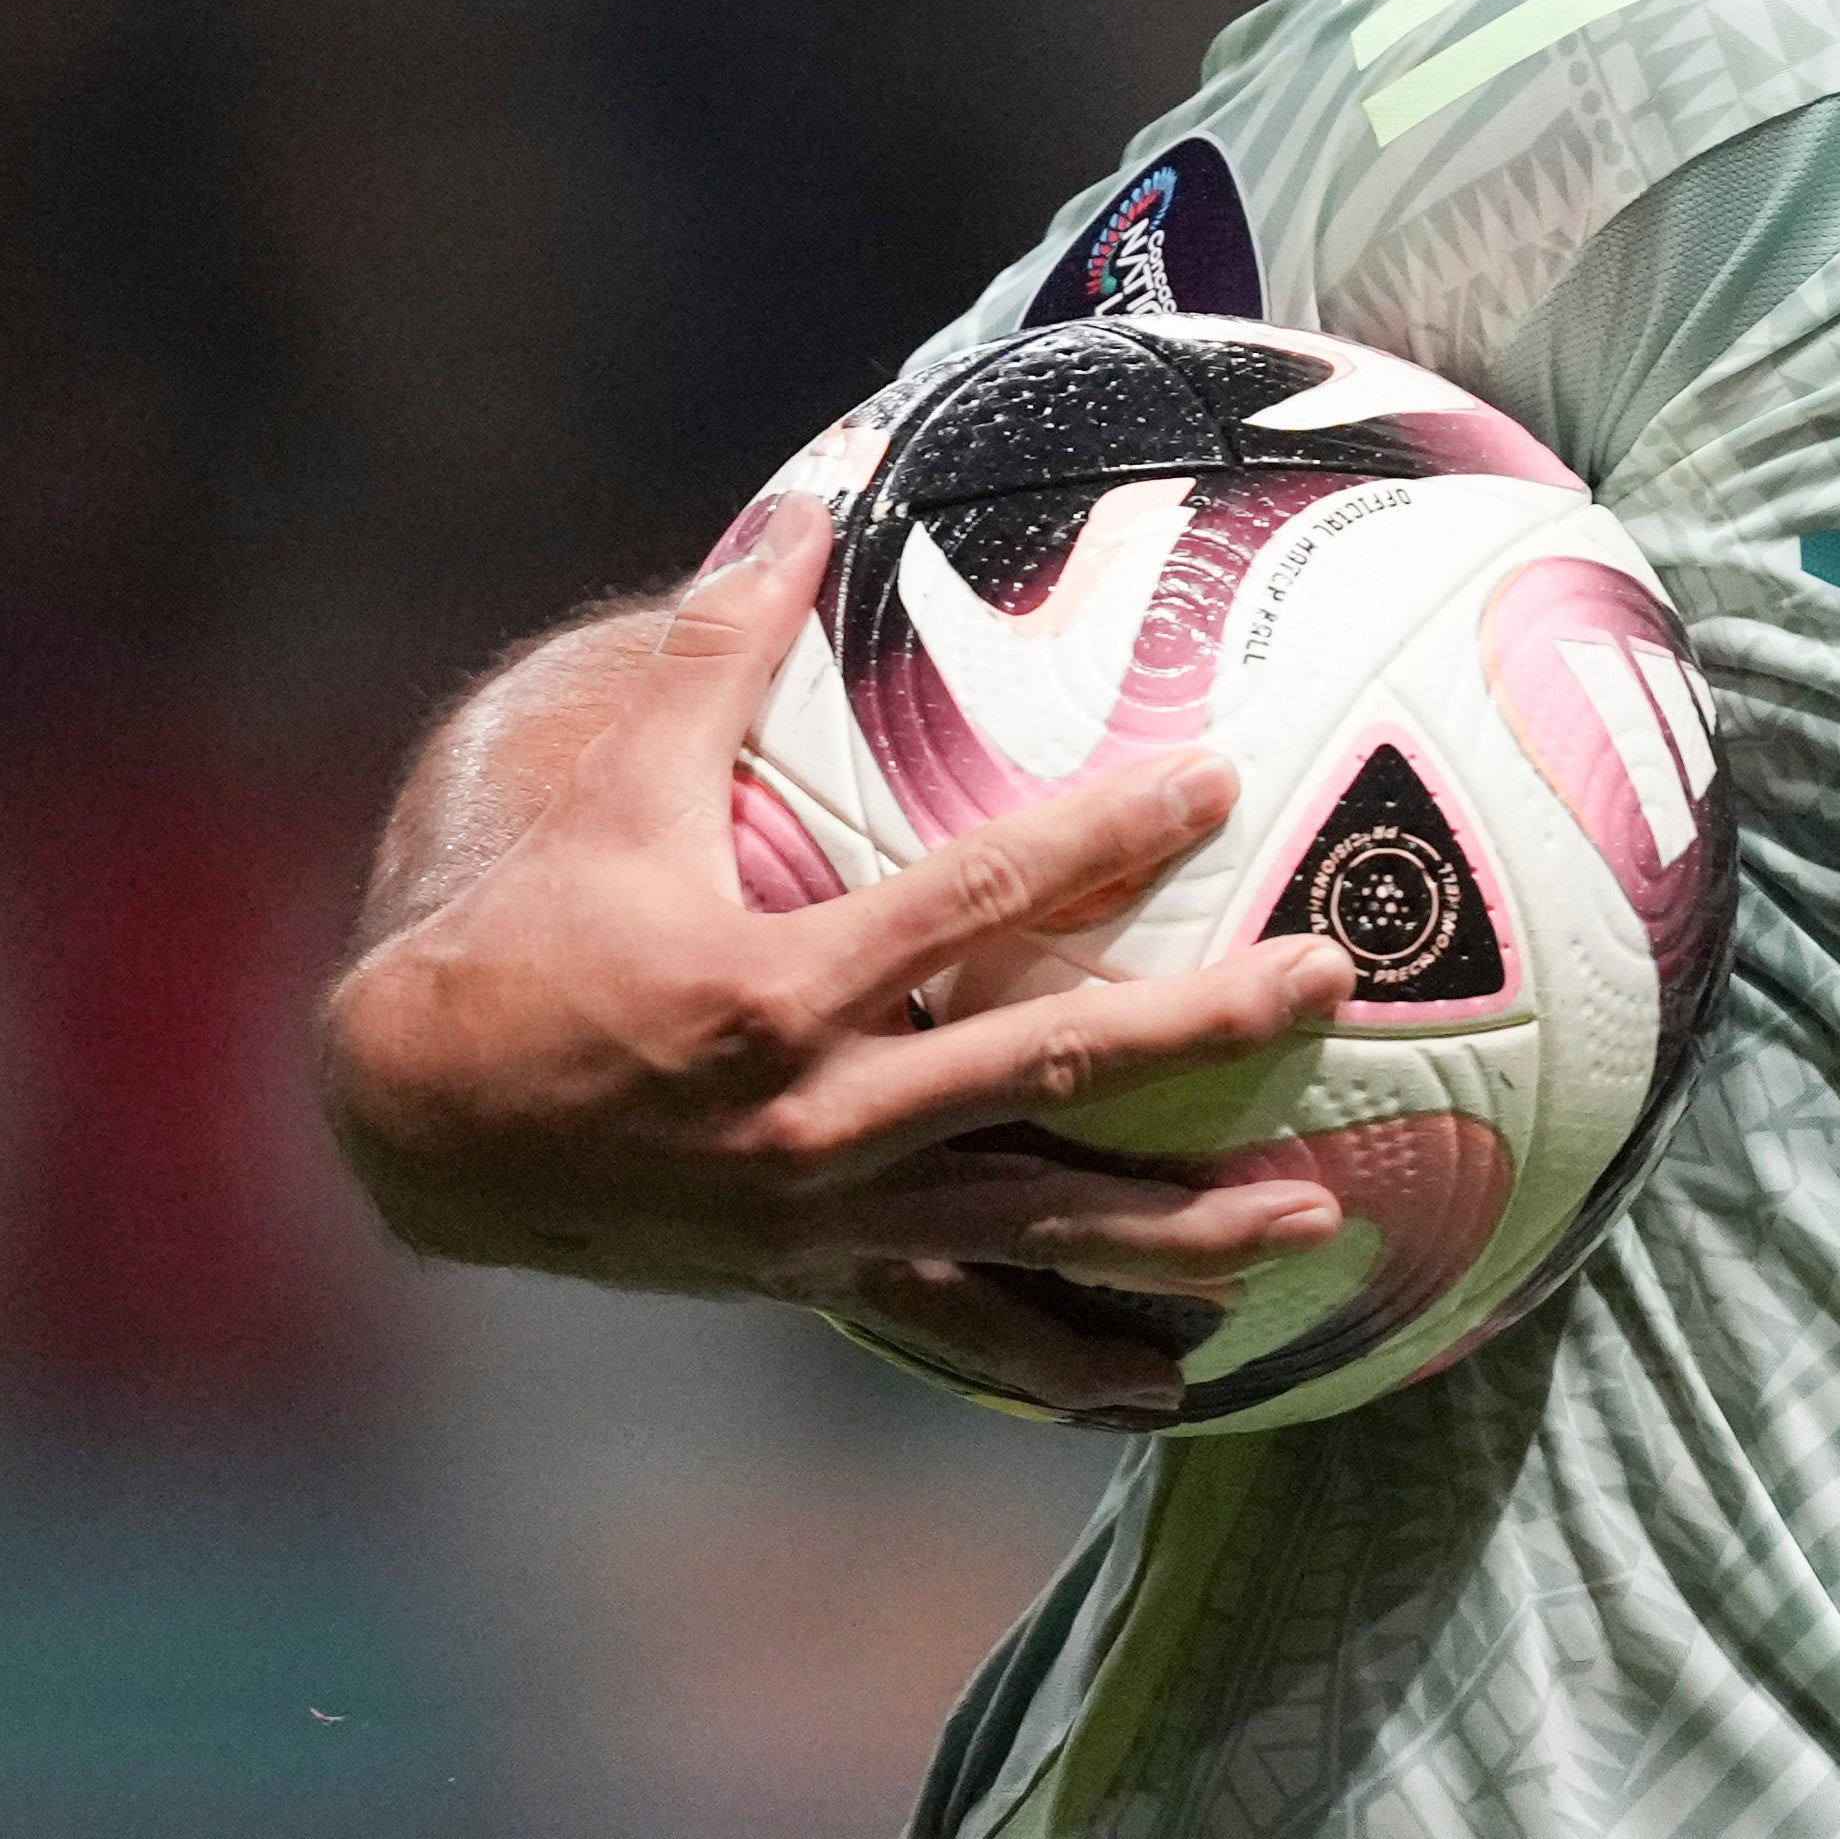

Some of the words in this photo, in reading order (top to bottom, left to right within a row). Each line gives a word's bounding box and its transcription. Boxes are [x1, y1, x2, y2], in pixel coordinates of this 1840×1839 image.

[1312, 488, 1412, 536] OFFICIAL
[1266, 536, 1318, 602] MATCH
[1243, 608, 1278, 665] BALL
